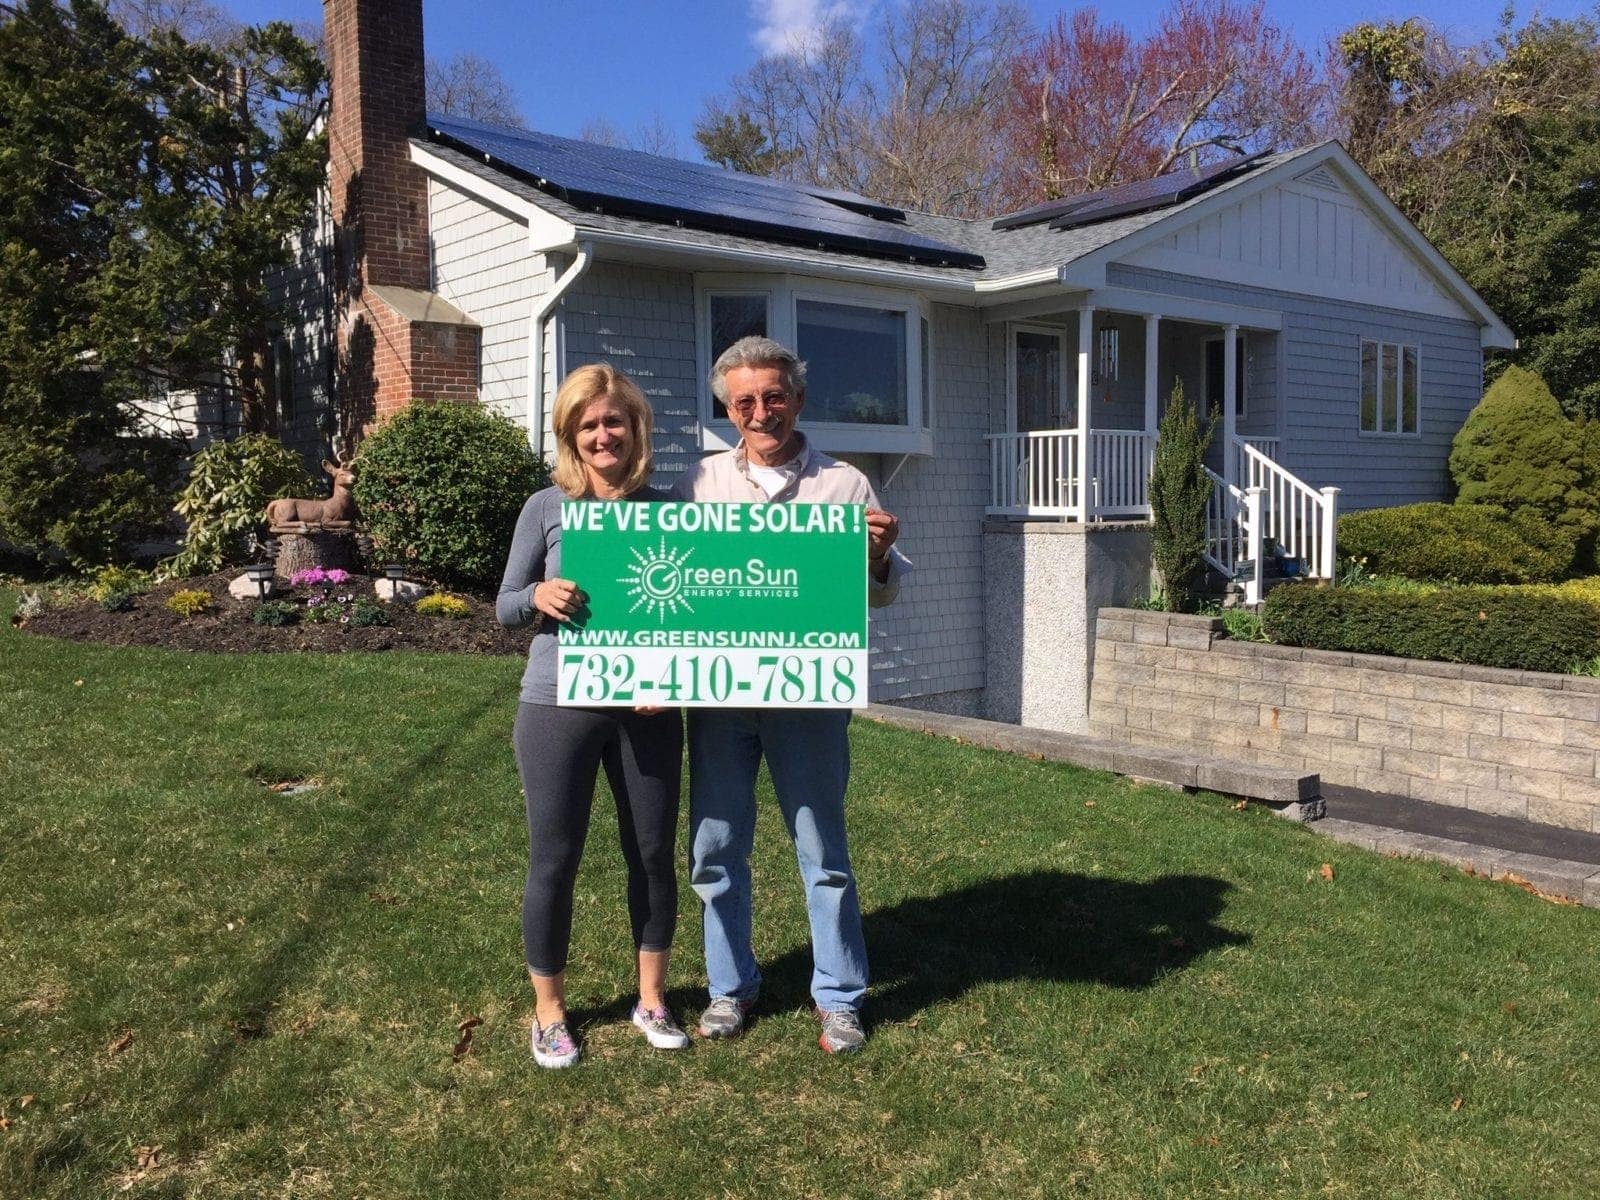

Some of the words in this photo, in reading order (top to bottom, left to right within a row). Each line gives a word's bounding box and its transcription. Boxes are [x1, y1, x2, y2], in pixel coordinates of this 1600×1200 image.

[561, 502, 650, 531] WE'VE
[657, 503, 741, 532] GONE
[684, 589, 732, 597] ENERGY
[738, 589, 799, 598] SERVICES
[558, 629, 860, 648] WWW.GREENSUNNJ.COM
[562, 653, 856, 703] 732-410-7818
